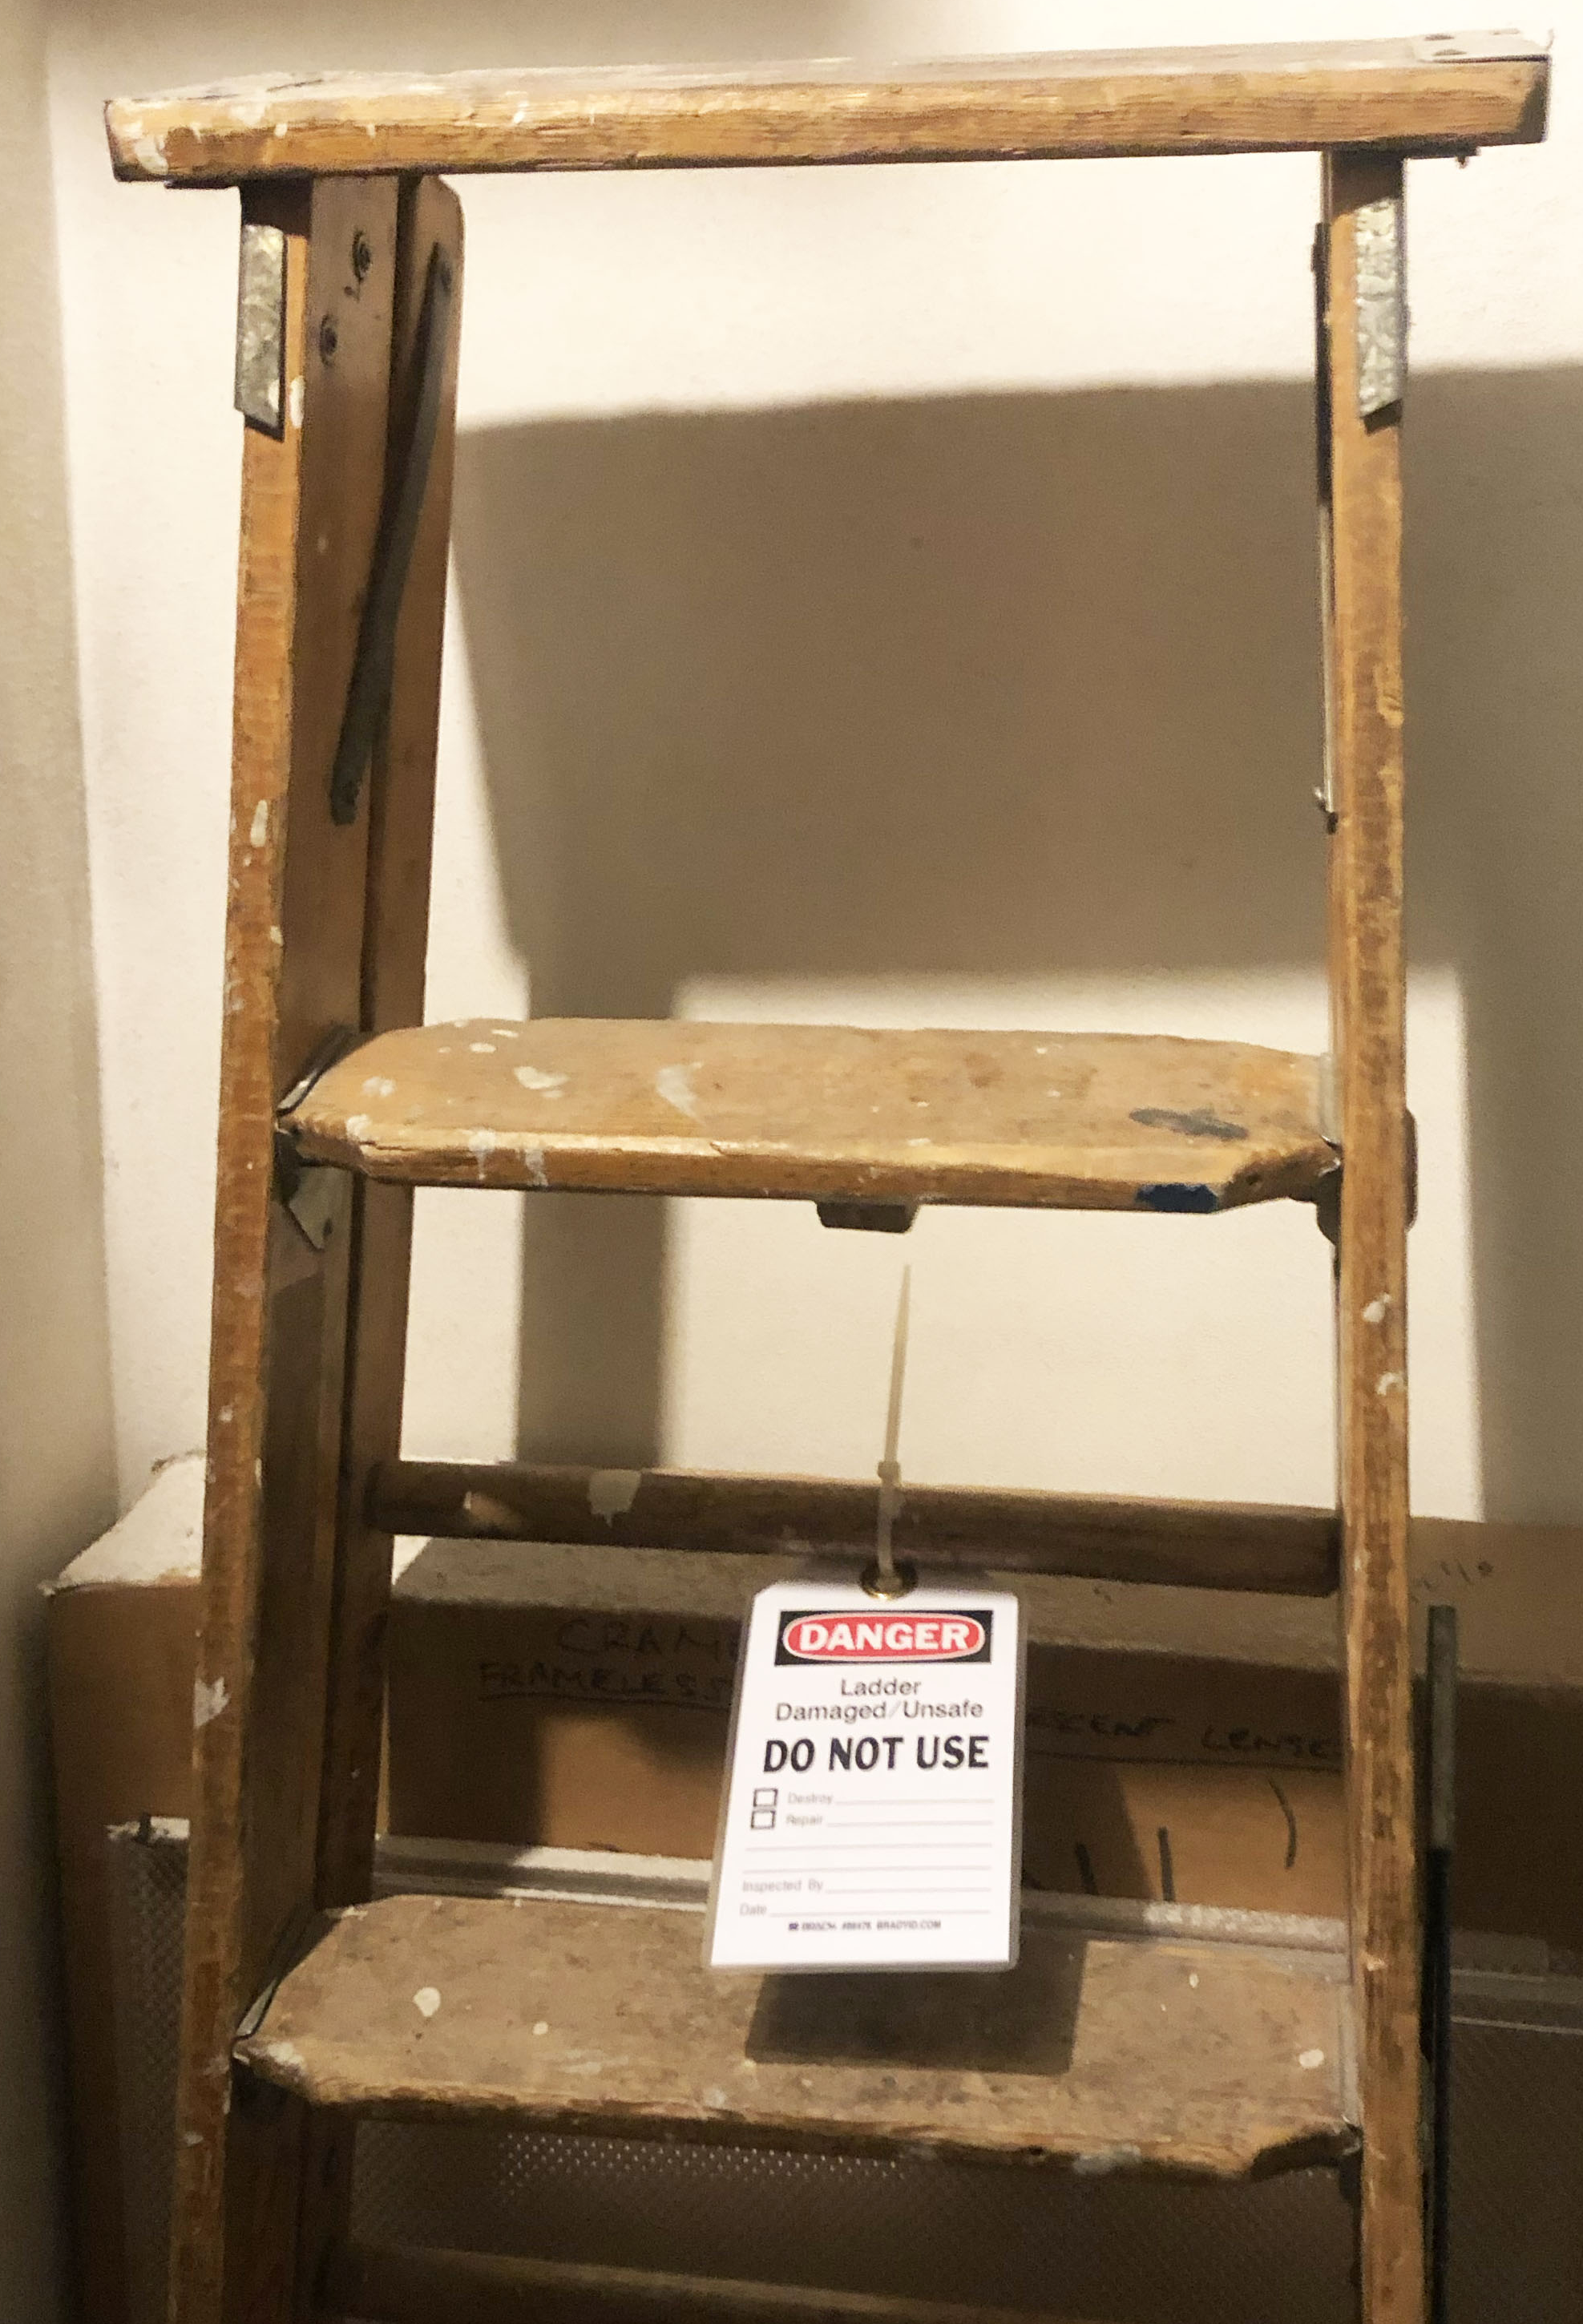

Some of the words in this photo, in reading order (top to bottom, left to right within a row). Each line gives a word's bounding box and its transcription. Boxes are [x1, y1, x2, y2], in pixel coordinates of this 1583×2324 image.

[798, 1622, 971, 1651] DANGER
[840, 1677, 922, 1697] Ladder
[775, 1700, 983, 1724] Damaged/Unsafe
[762, 1737, 816, 1773] DO
[827, 1736, 904, 1772] NOT
[915, 1734, 990, 1770] USE
[787, 1791, 834, 1806] Destroy
[785, 1813, 824, 1828] Repair
[741, 1879, 802, 1895] Inspected
[807, 1878, 824, 1894] By
[739, 1903, 768, 1918] Date
